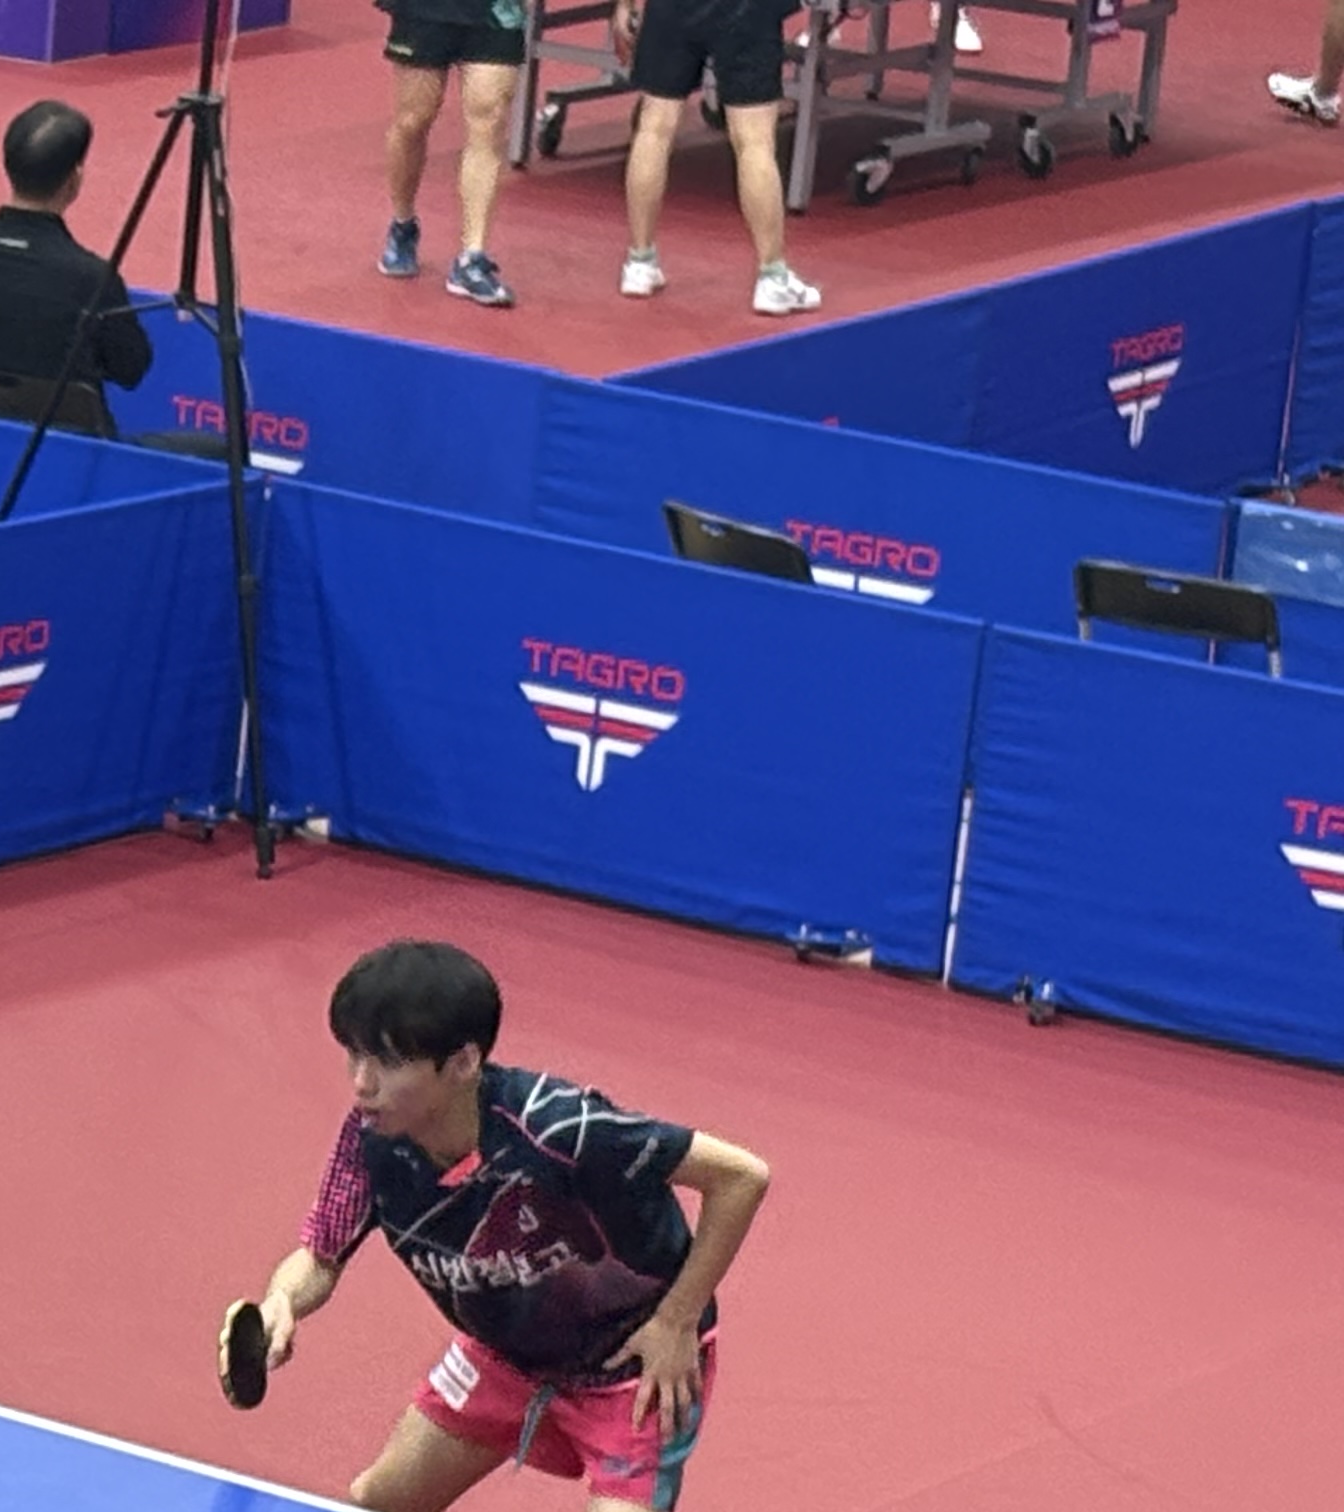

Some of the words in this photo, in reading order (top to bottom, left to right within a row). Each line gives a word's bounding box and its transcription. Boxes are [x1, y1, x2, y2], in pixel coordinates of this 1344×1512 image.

[172, 394, 308, 451] TARO
[786, 519, 940, 577] TAGRO
[521, 637, 685, 702] TAGRO
